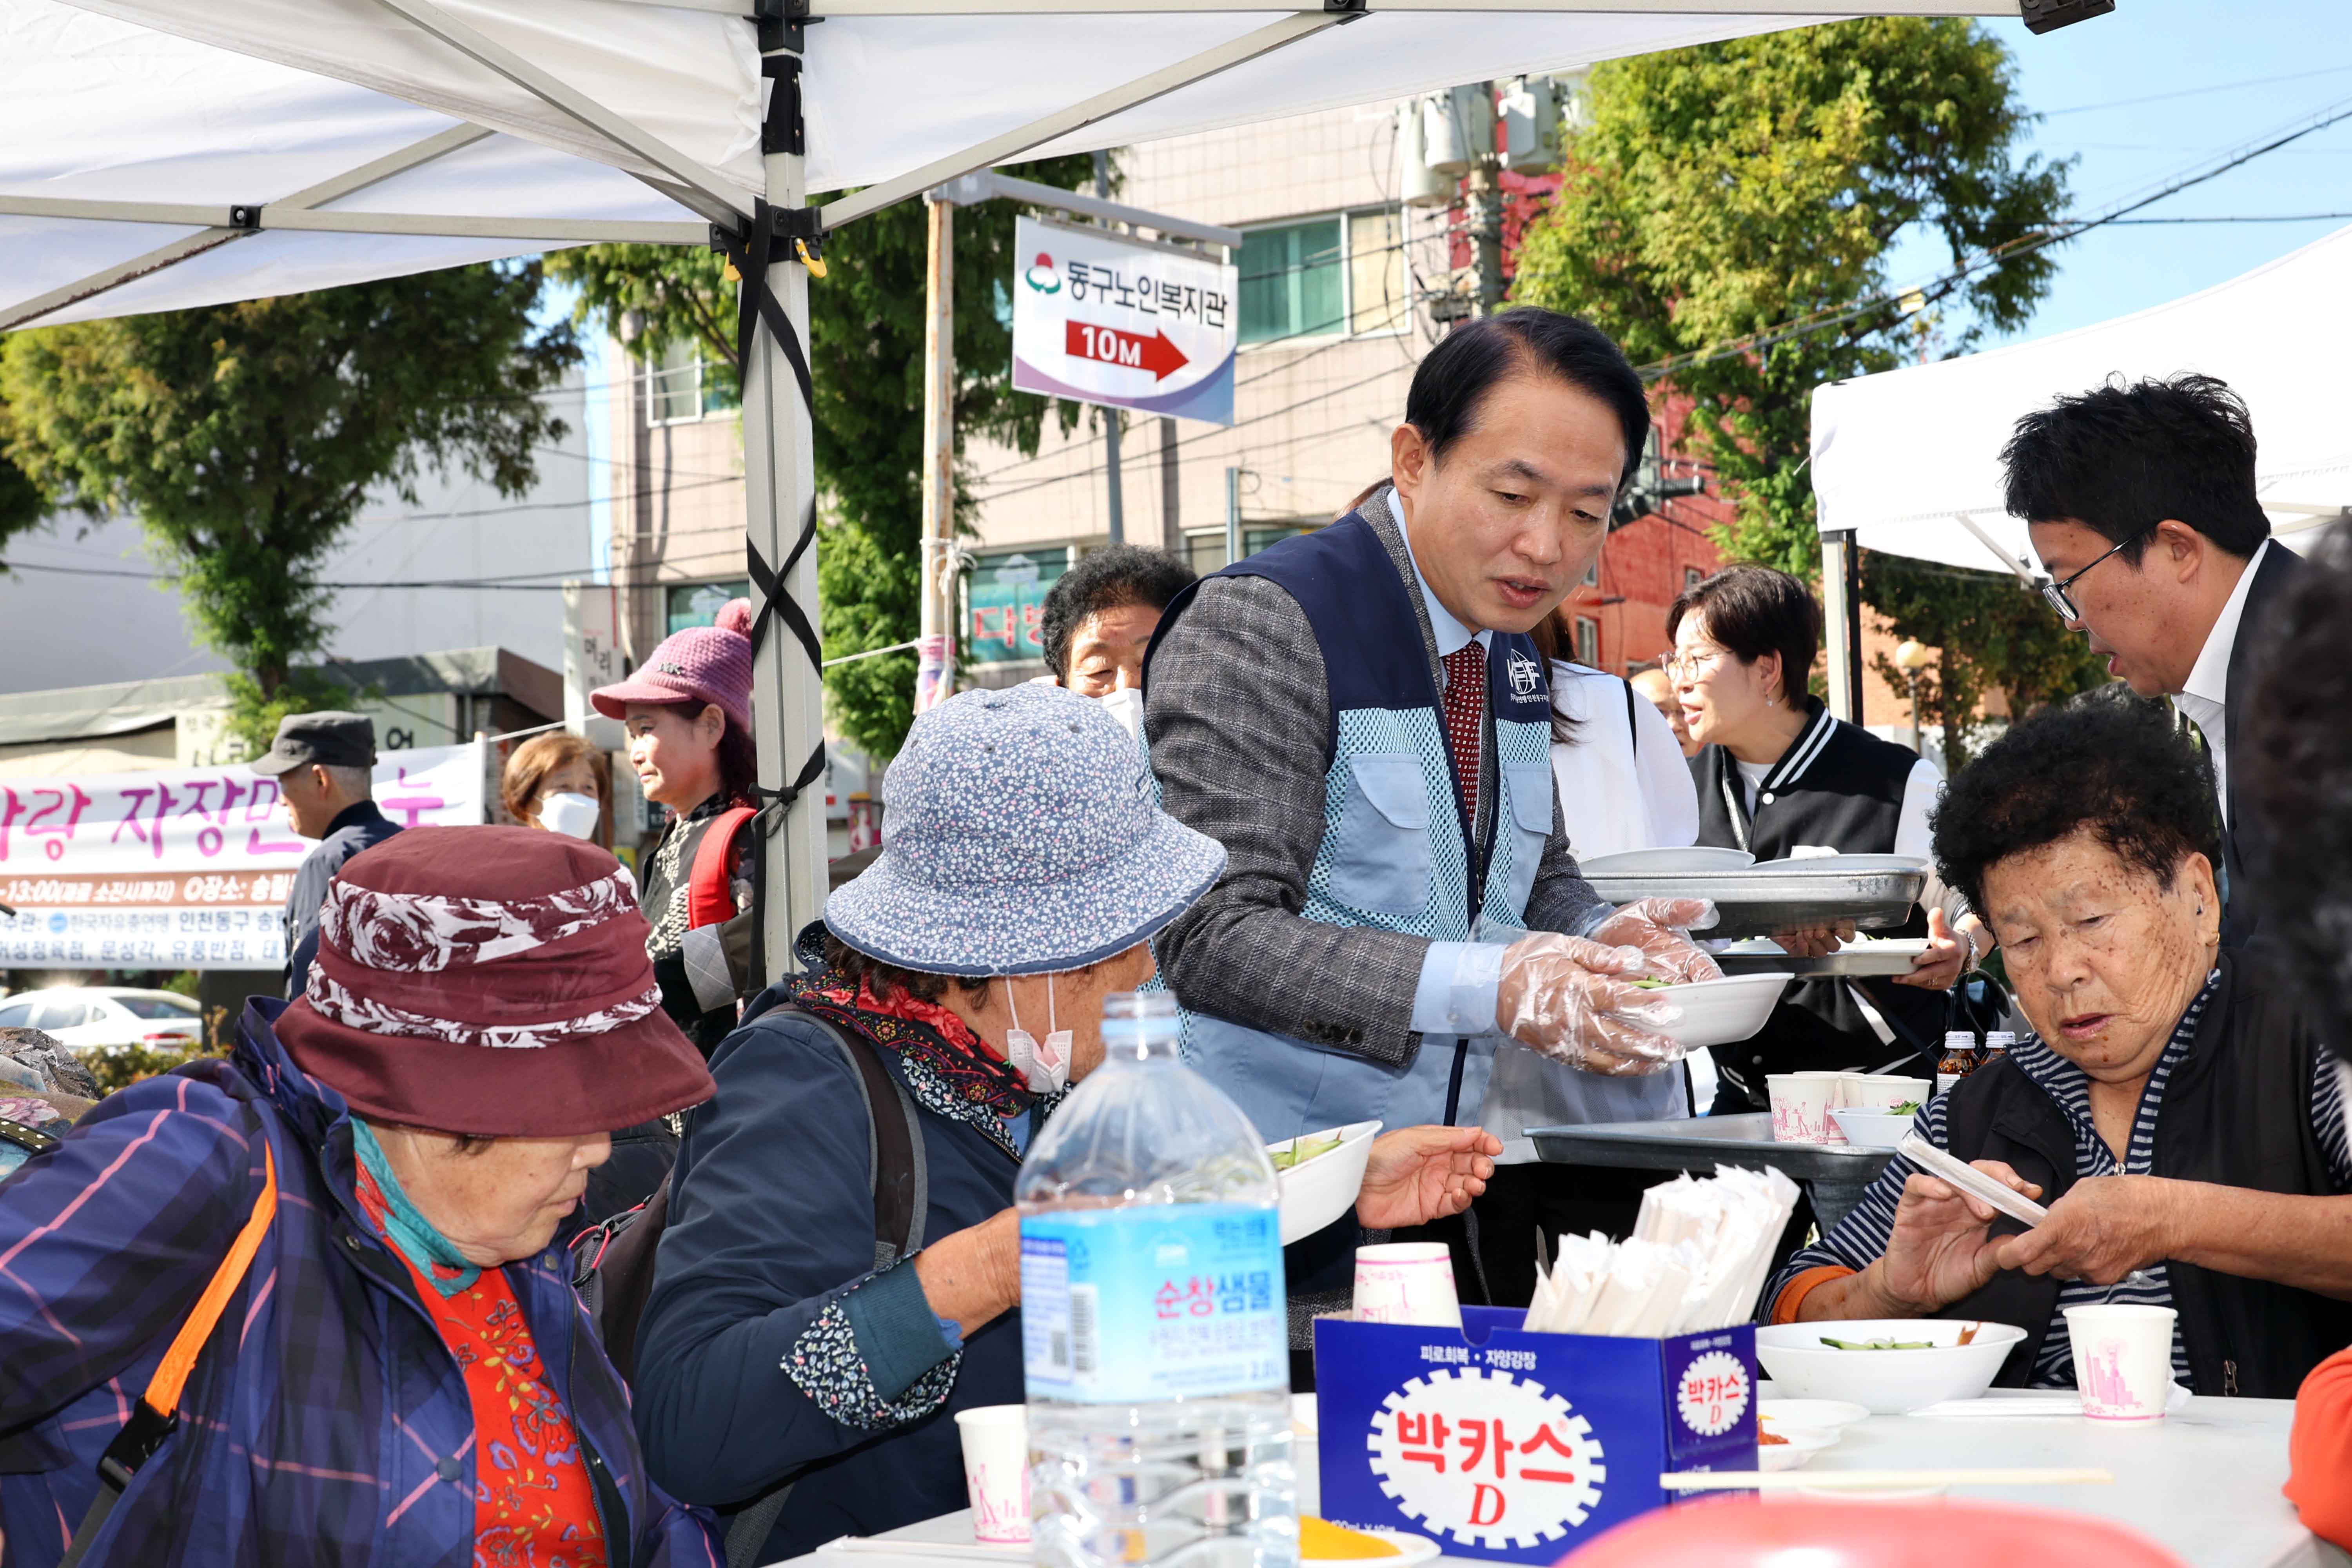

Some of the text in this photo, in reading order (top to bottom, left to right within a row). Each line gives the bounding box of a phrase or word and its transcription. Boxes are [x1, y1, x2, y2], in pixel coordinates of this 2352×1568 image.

[1068, 260, 1227, 328] 동구노인복지관
[1081, 326, 1141, 367] 10M
[179, 911, 249, 933] 인천동구
[1156, 1271, 1271, 1319] 순창샘물
[1420, 1345, 1537, 1371] 피로회복 자양강장
[1688, 1375, 1740, 1405] 박카스
[1710, 1405, 1722, 1425] D
[1397, 1411, 1575, 1483] 박카스
[1467, 1483, 1506, 1526] D
